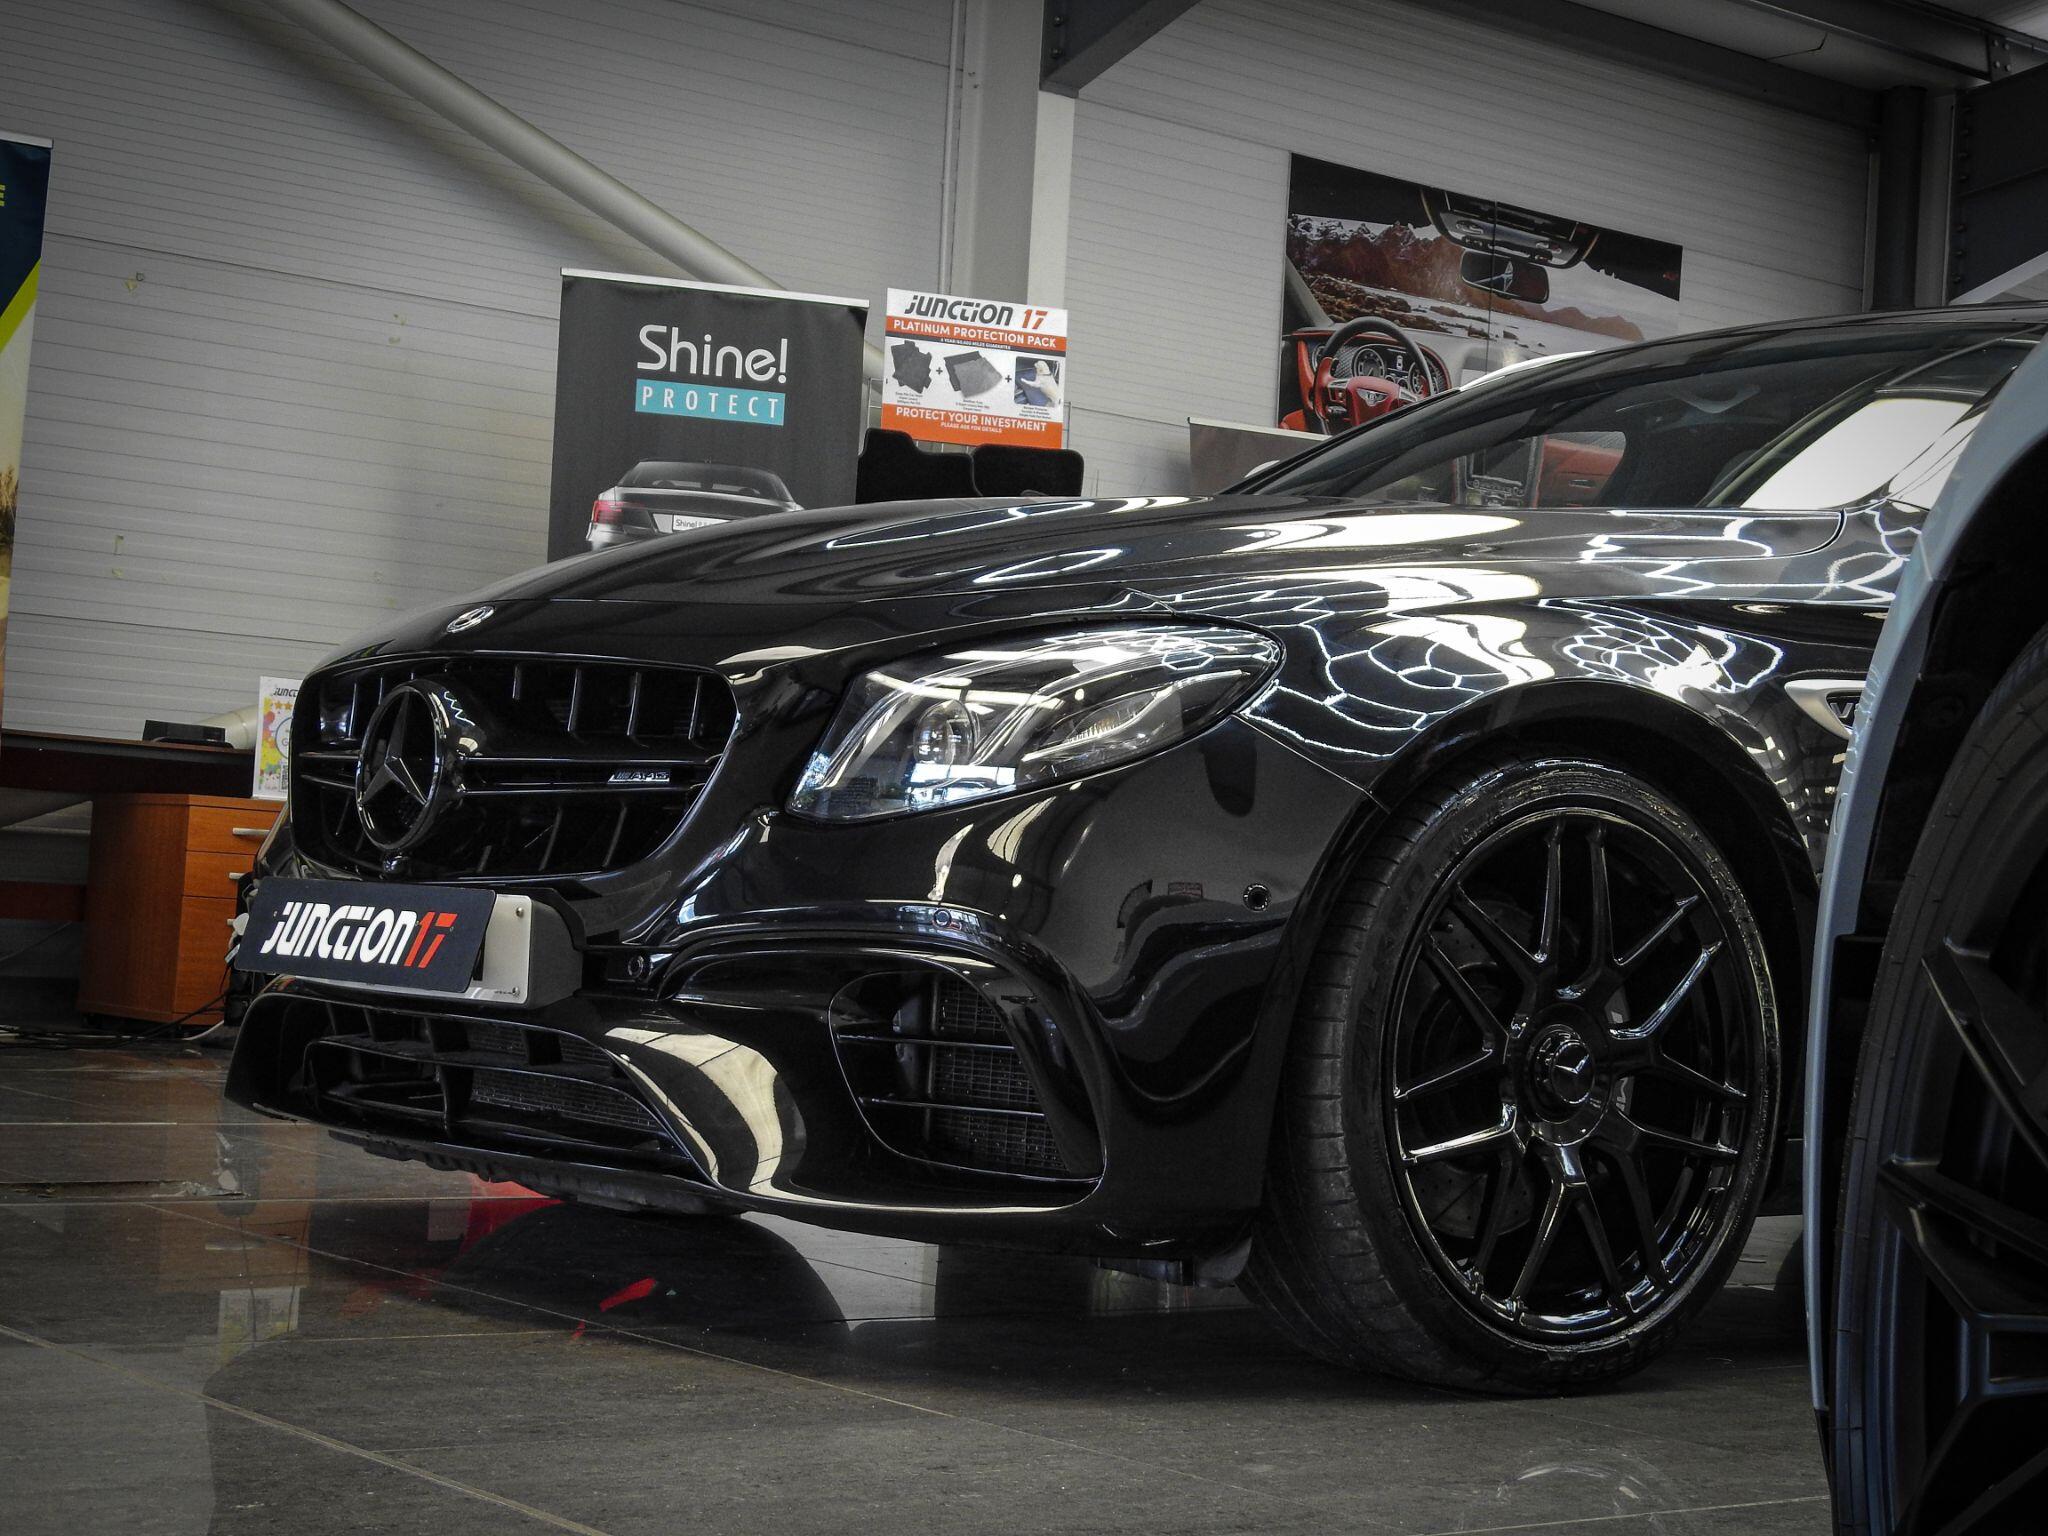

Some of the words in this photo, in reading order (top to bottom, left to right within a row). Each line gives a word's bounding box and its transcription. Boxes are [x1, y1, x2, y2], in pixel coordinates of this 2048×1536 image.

[1021, 308, 1049, 330] 17
[893, 319, 950, 336] PLATINUM
[953, 325, 1024, 344] PROTECTION
[1027, 334, 1057, 349] PACK
[636, 323, 788, 384] Shine!
[641, 385, 779, 419] PROTECT
[895, 407, 946, 422] PROTECT
[948, 412, 978, 426] YOUR
[981, 414, 1048, 432] INVESTMENT
[675, 519, 698, 528] Shine!
